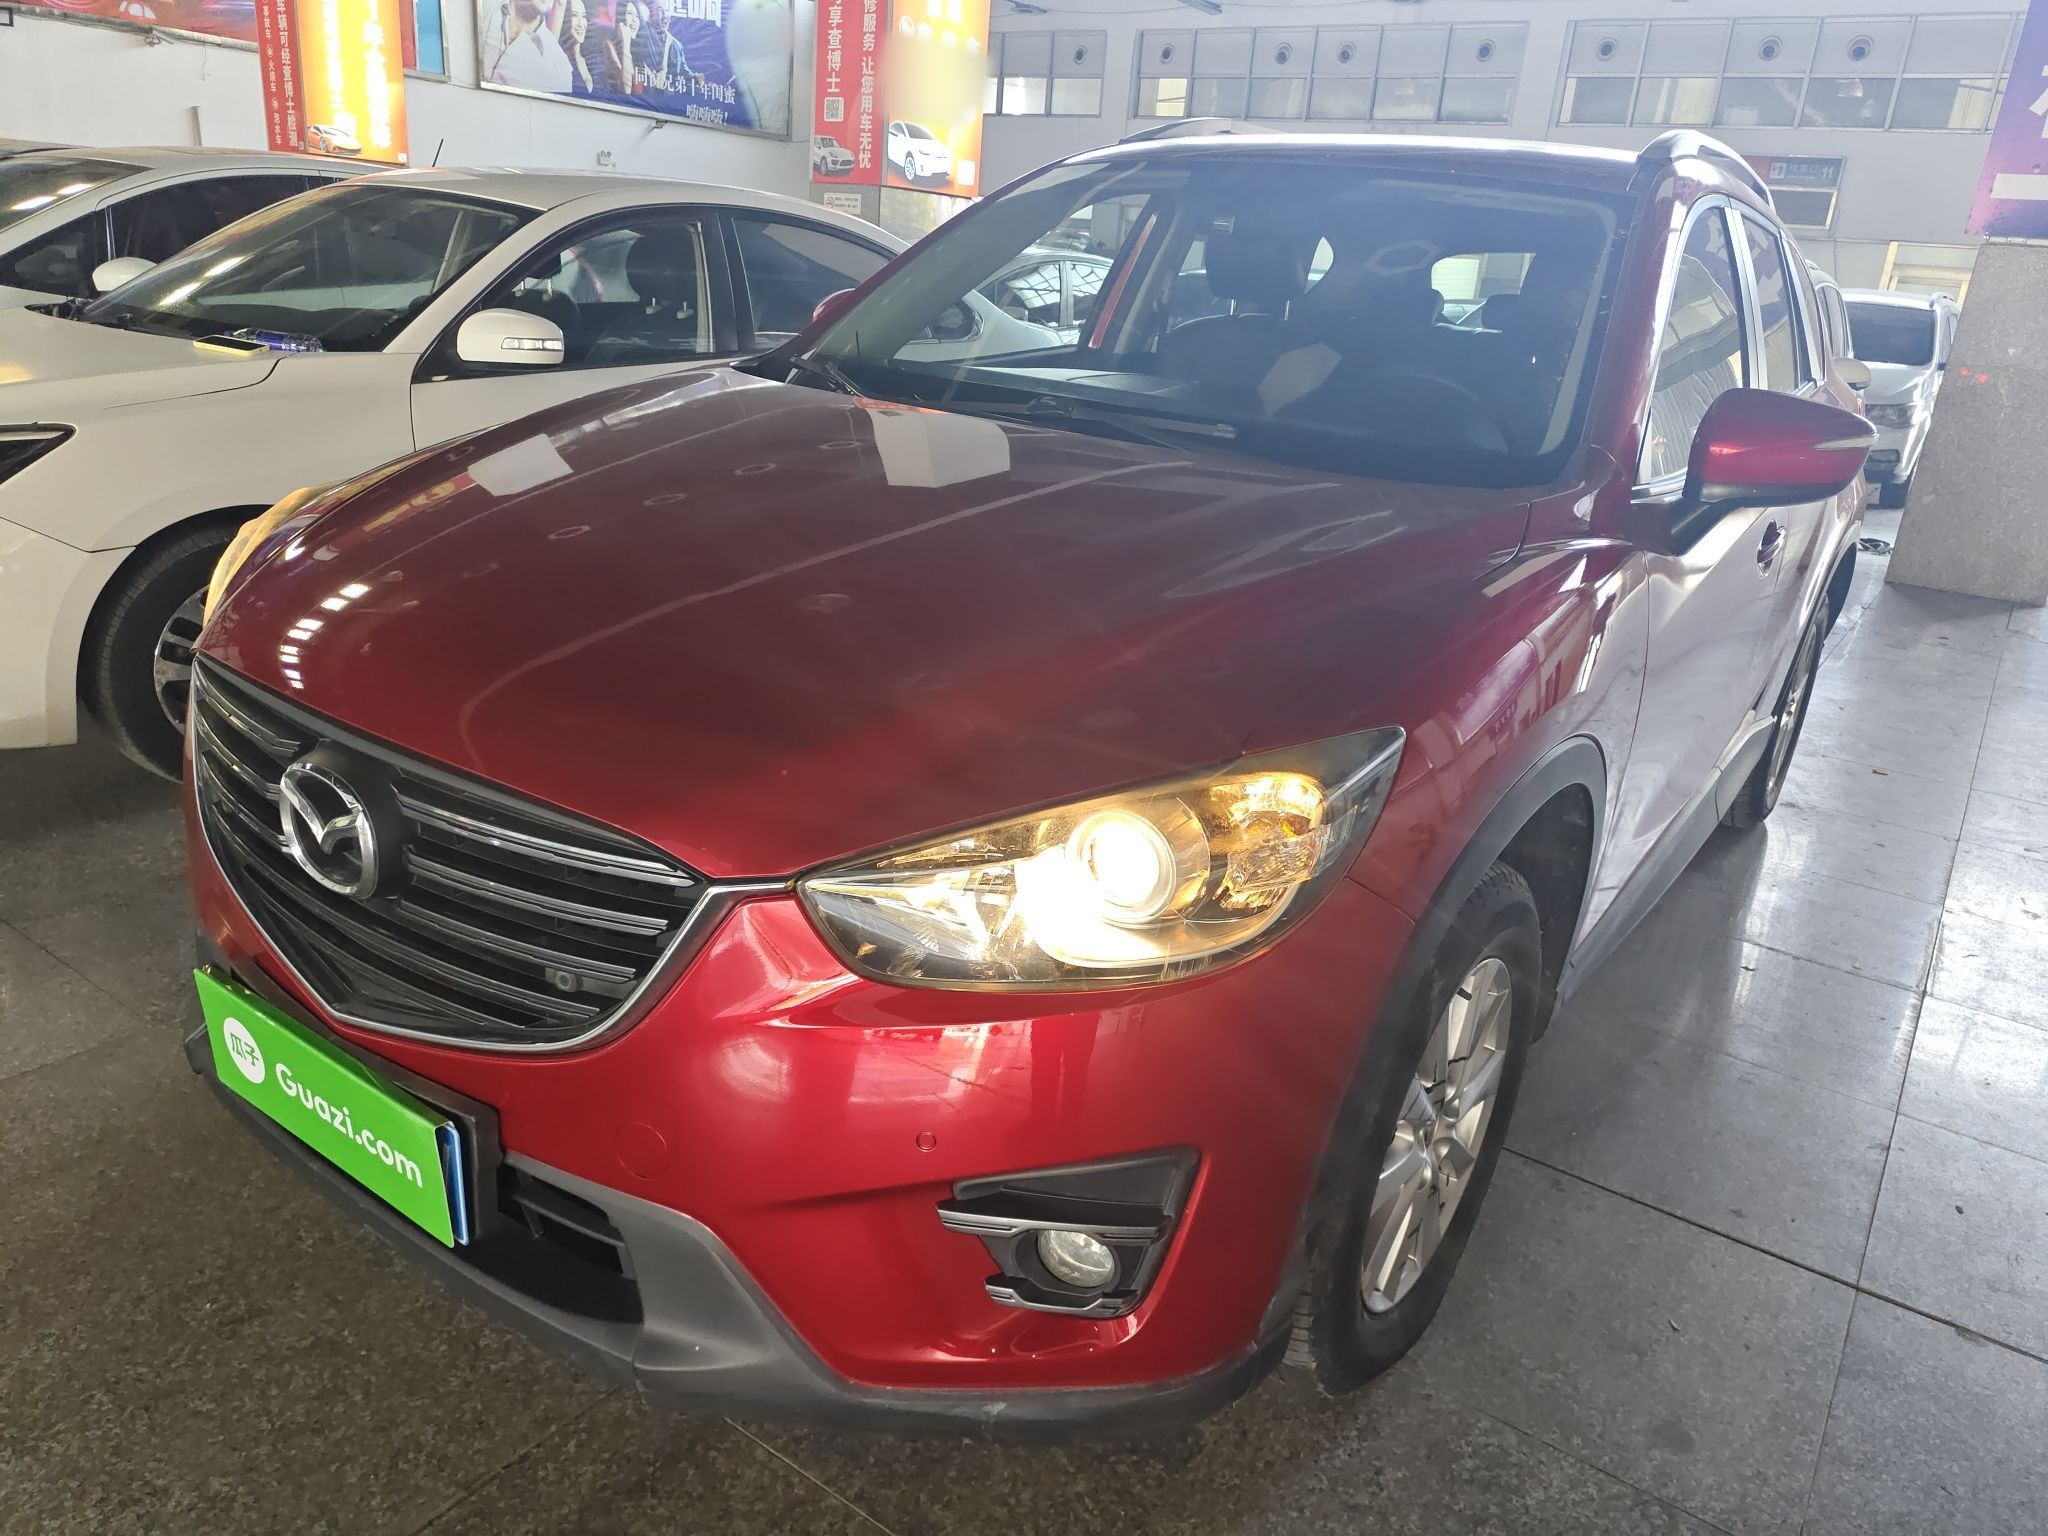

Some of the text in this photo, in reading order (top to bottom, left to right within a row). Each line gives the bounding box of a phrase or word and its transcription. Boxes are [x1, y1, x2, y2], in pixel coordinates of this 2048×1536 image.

[827, 0, 843, 93] 享查博士
[859, 56, 875, 169] 让您用车无忧
[229, 1032, 260, 1067] 瓜子
[275, 1063, 423, 1188] Guazi.com
